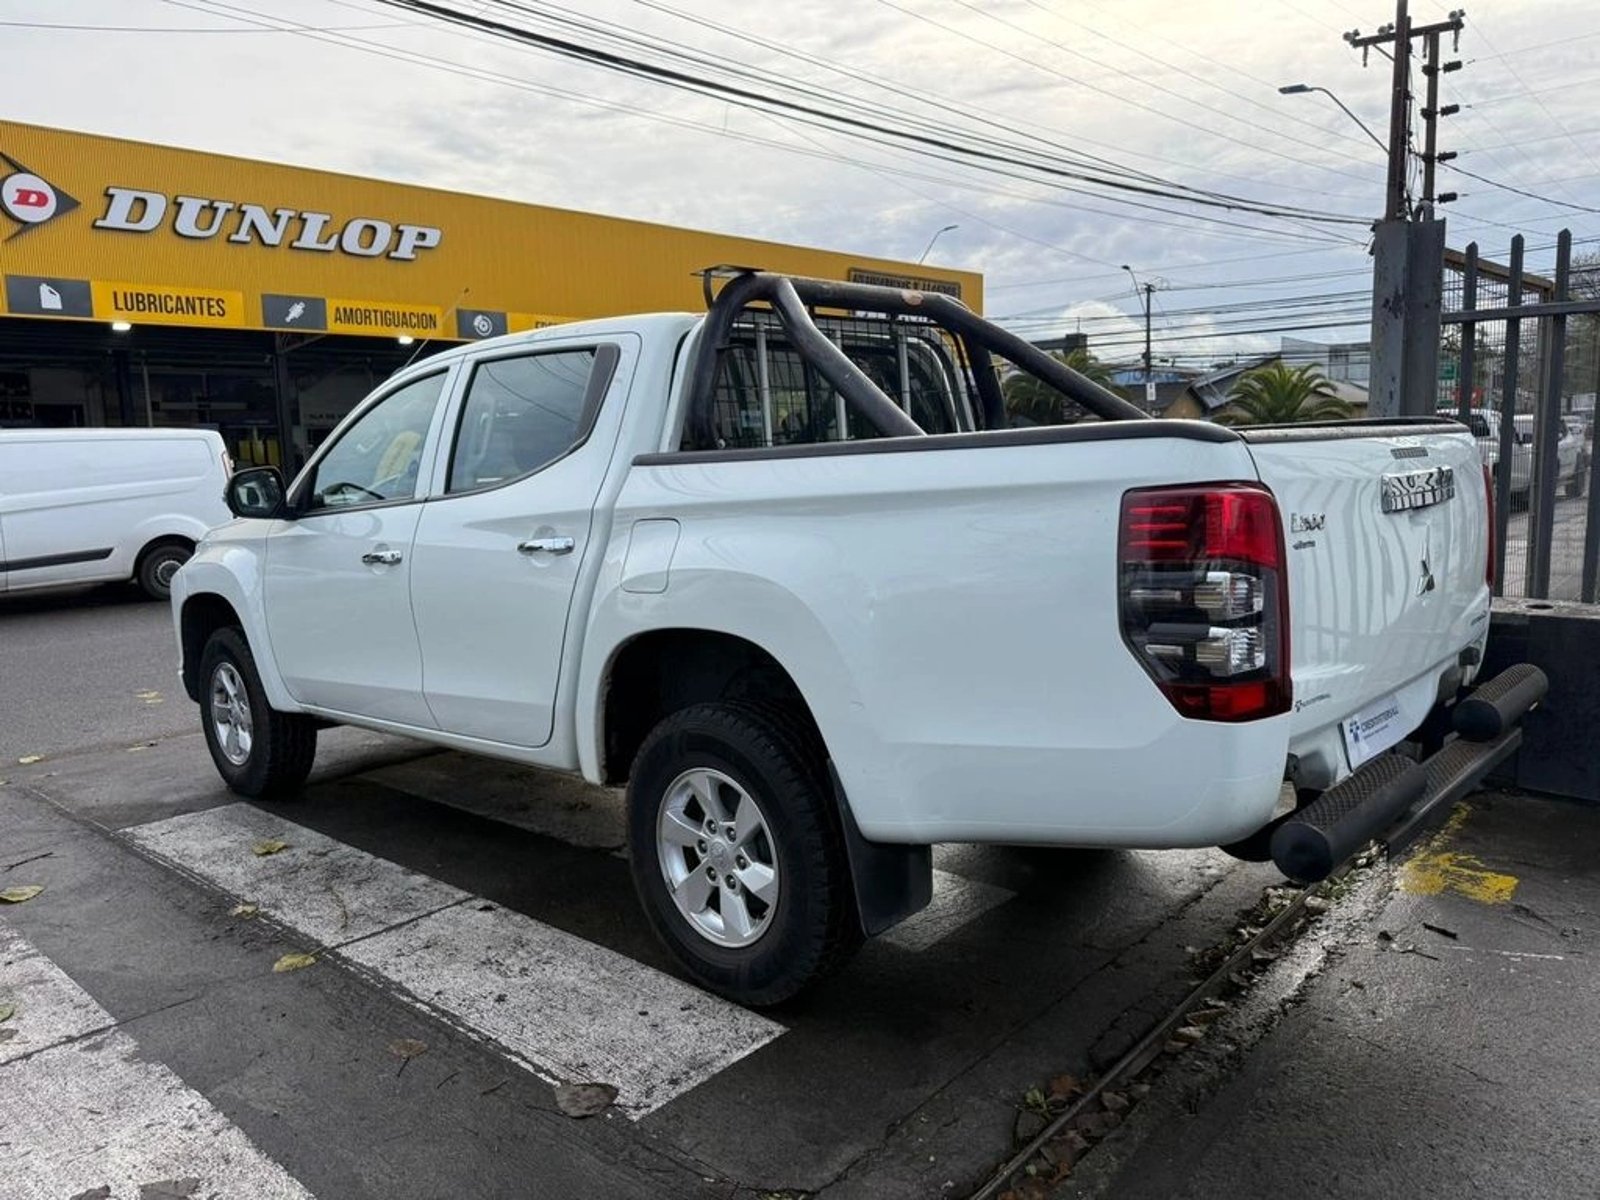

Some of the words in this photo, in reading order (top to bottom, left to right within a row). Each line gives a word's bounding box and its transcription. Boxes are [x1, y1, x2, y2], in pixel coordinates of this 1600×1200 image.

[12, 188, 49, 208] D
[94, 186, 442, 260] DUNLOP
[112, 290, 226, 317] LUBRICANTES
[334, 306, 437, 330] AMORTIGUACION
